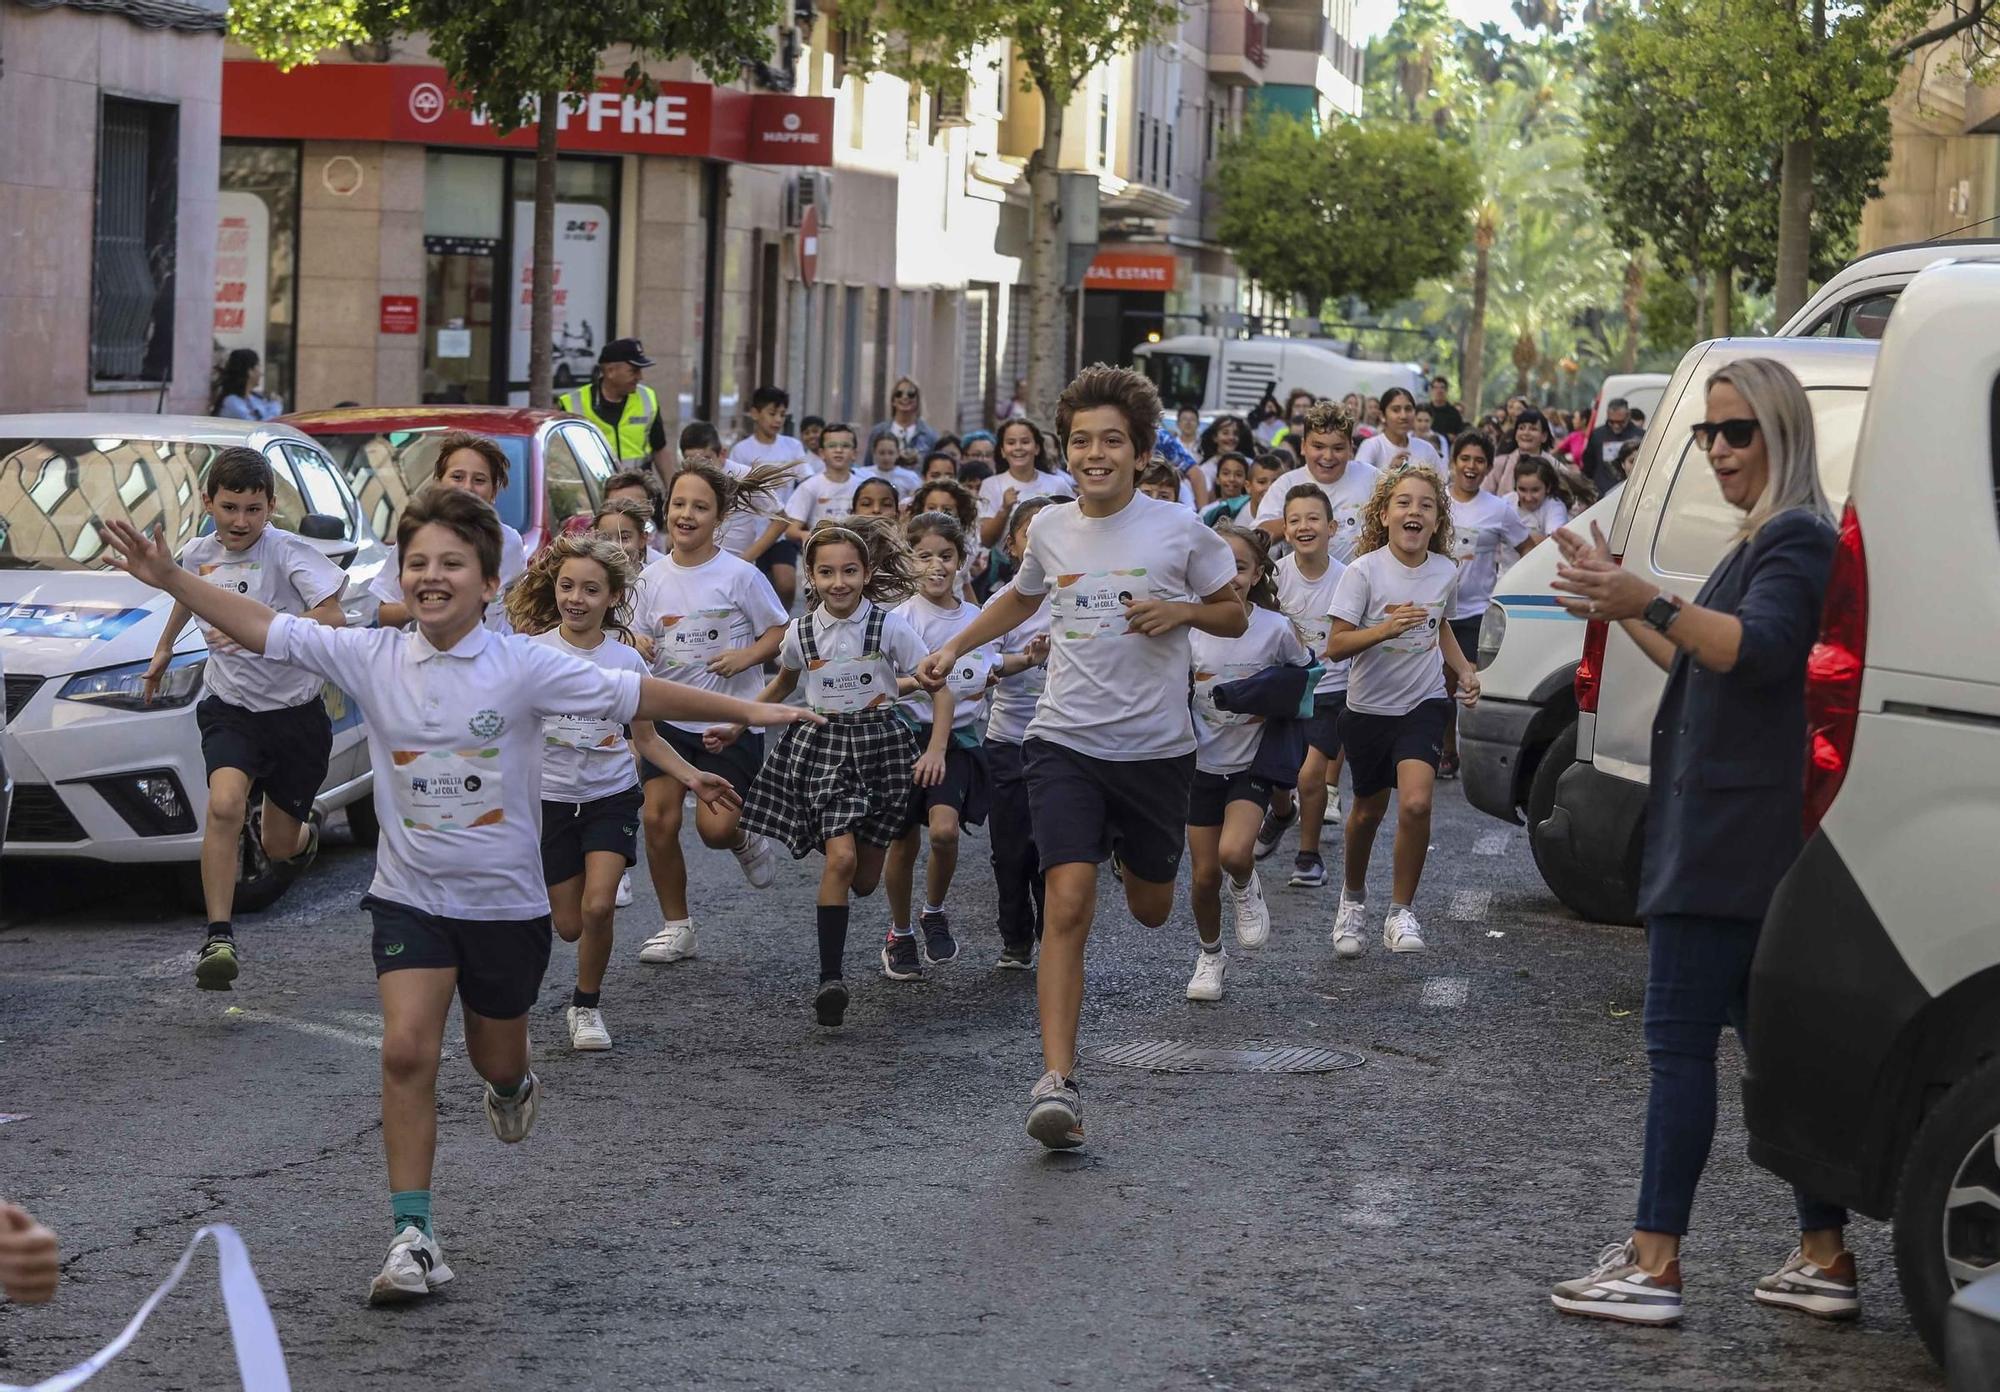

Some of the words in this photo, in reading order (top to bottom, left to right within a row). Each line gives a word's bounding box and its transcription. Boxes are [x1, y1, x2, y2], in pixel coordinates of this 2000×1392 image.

[763, 131, 820, 144] MAPFRE
[1115, 266, 1166, 281] ESTATE
[1097, 592, 1117, 600] VUELTA
[438, 777, 462, 785] VUELTA
[442, 787, 459, 795] COLE
